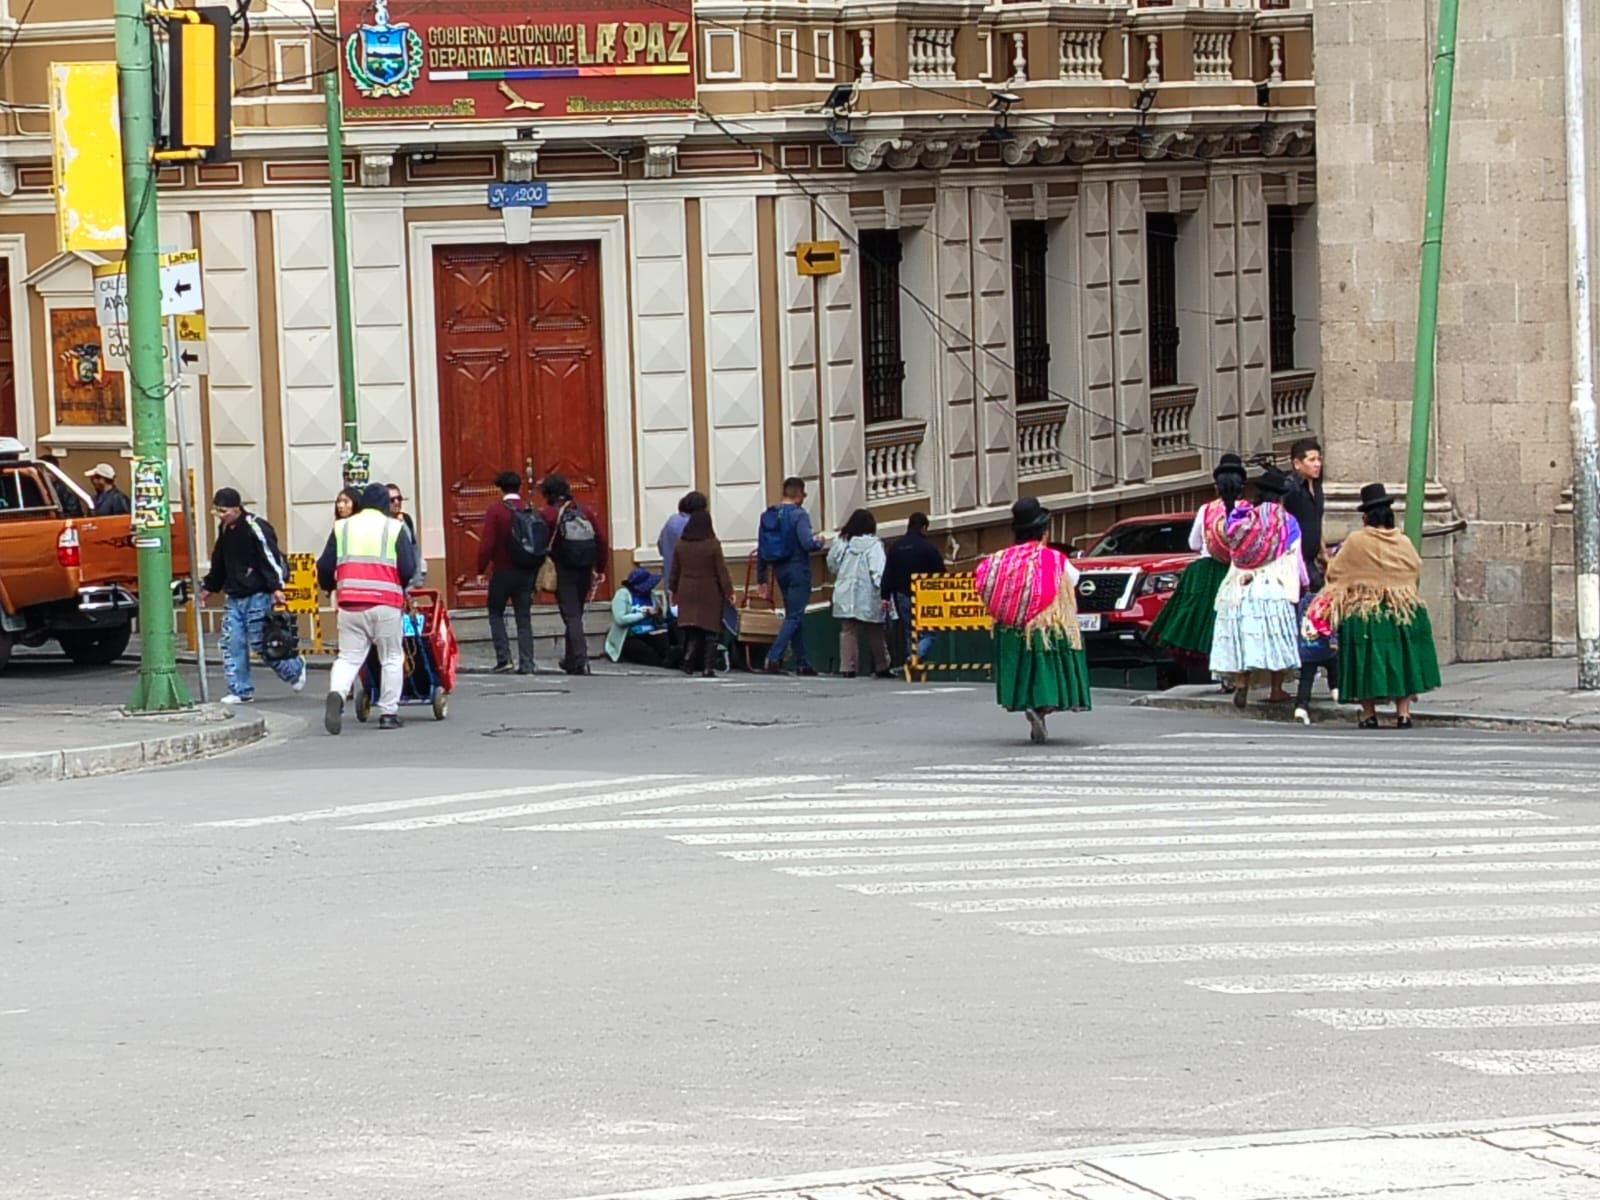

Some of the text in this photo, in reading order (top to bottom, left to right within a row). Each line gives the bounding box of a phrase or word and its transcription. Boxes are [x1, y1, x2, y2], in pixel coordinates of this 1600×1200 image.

[428, 25, 497, 46] GOBIERNO
[577, 21, 689, 64] LA PAZ
[429, 44, 576, 68] DEPARTAMENTAL DE
[512, 187, 543, 201] 1200
[943, 592, 954, 602] LA
